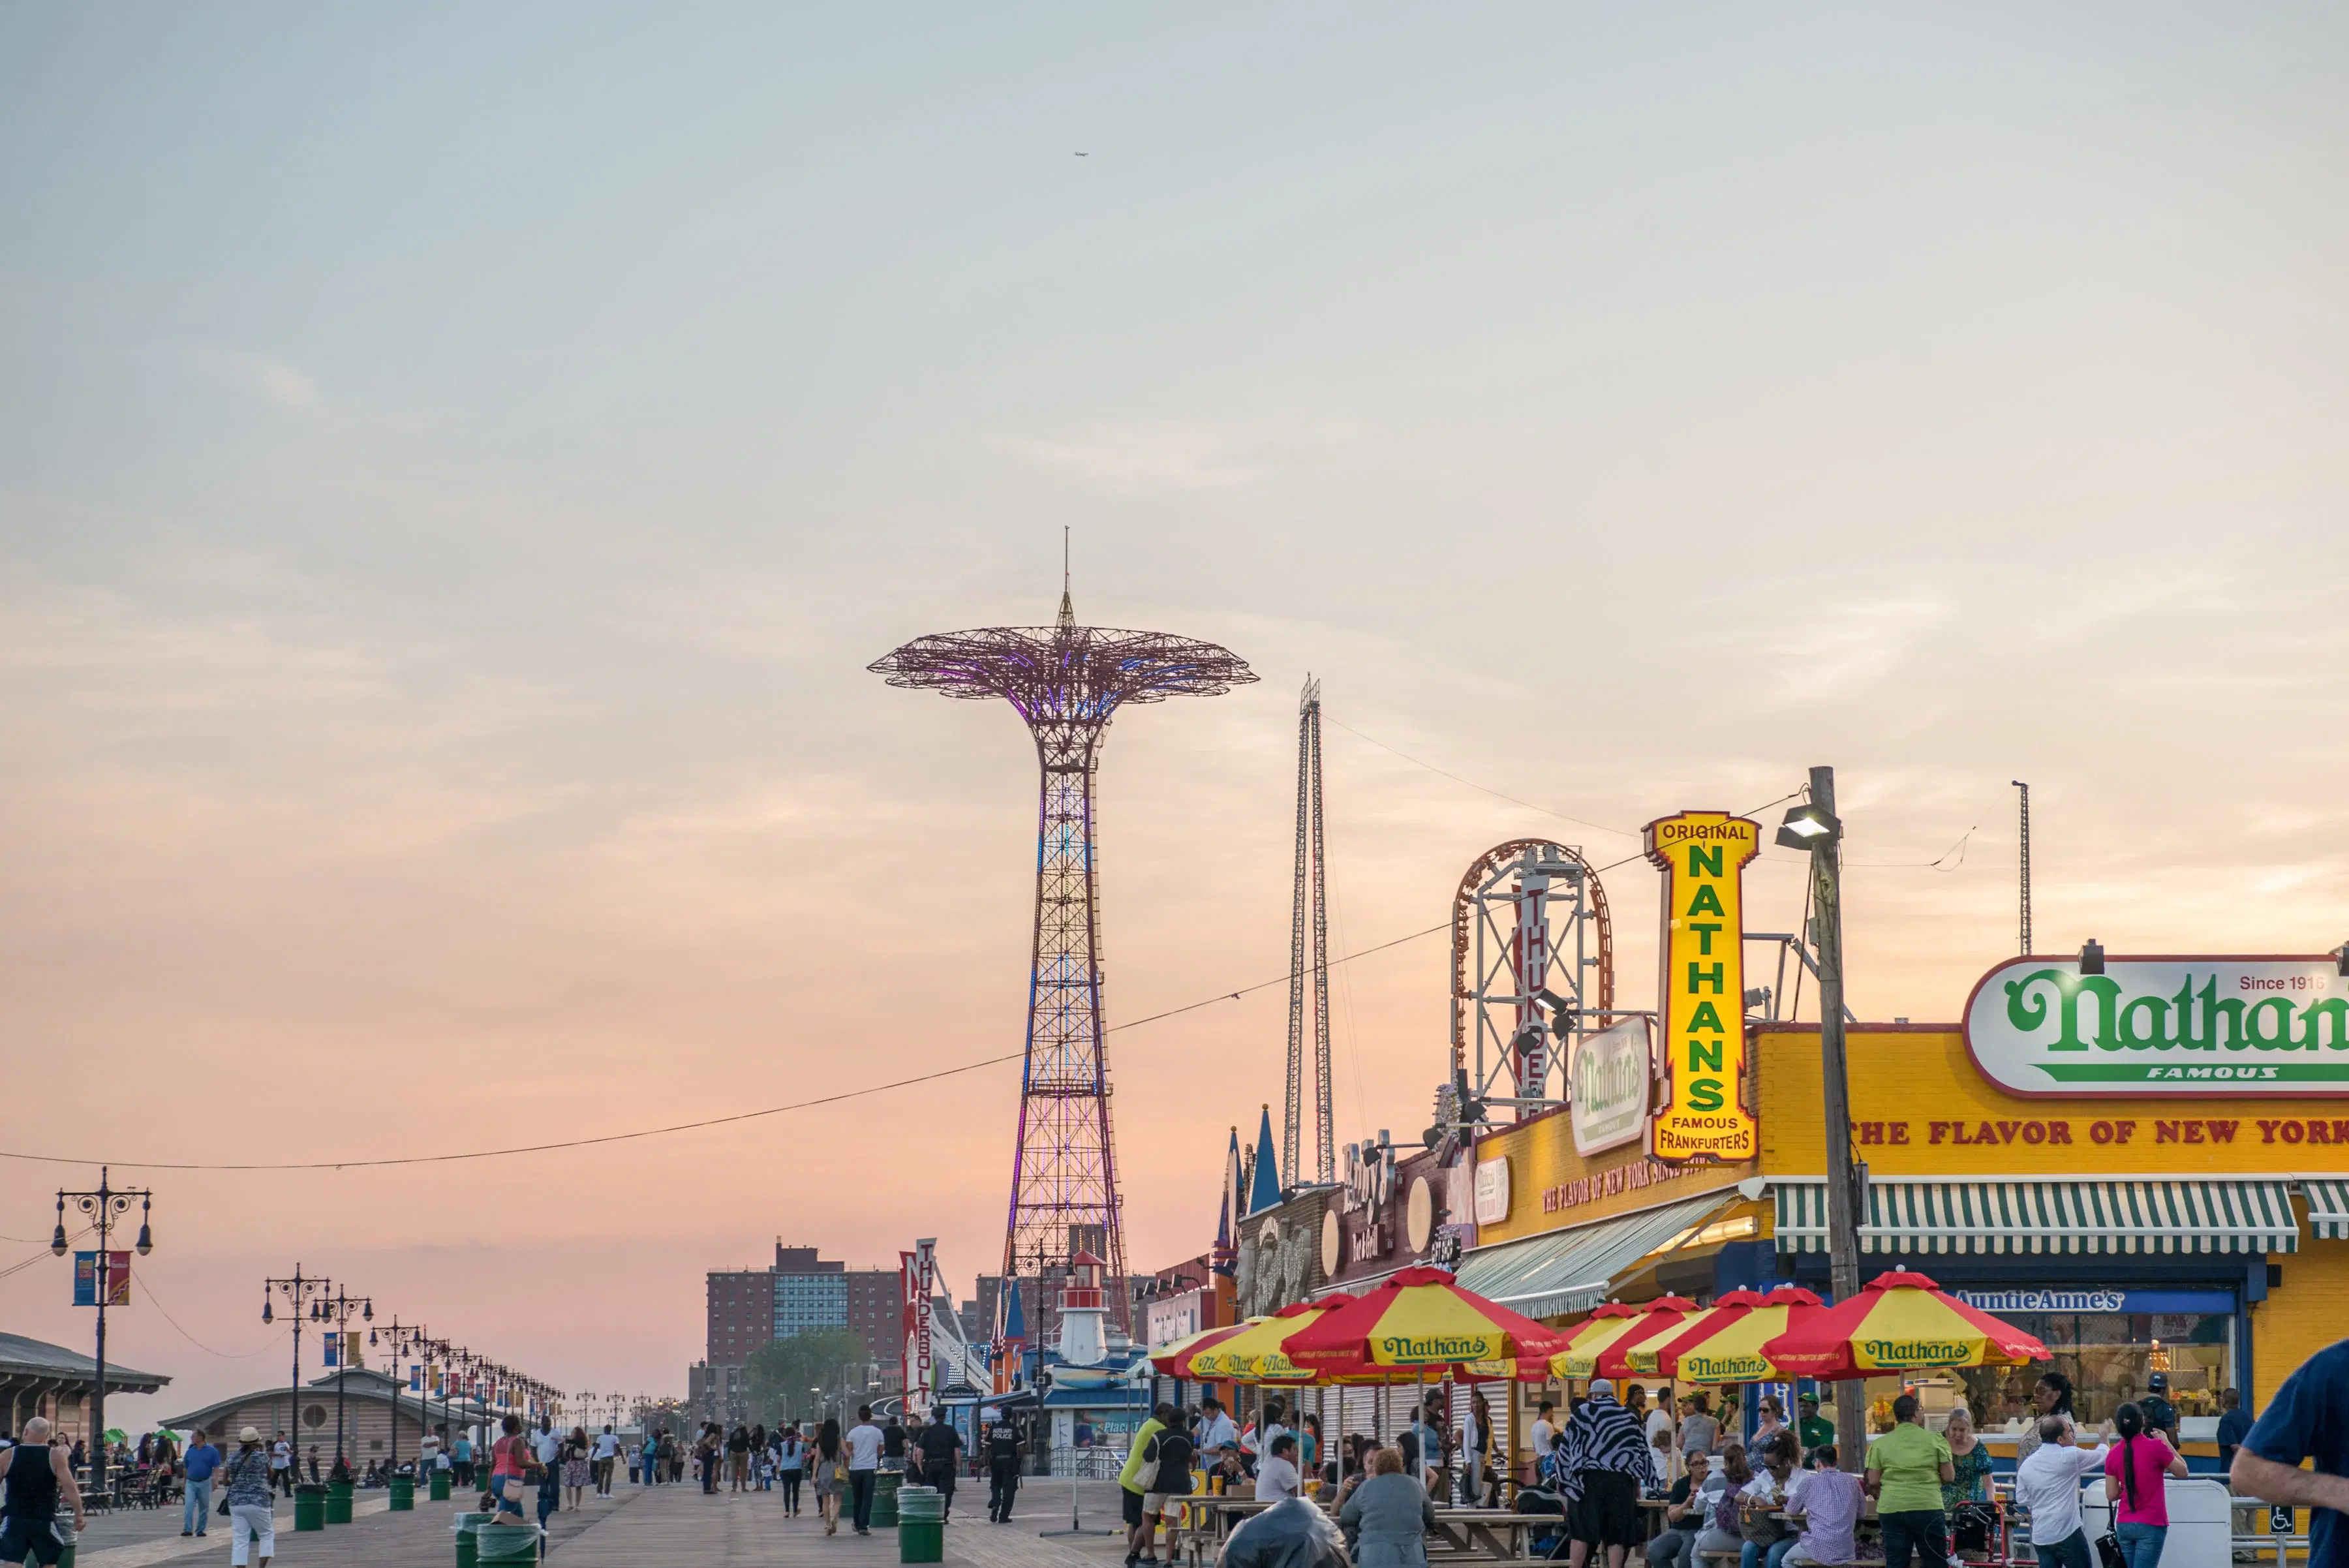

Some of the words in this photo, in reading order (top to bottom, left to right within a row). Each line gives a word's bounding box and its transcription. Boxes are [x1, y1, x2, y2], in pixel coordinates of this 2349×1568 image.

[1663, 824, 1749, 840] ORIGINAL
[1686, 845, 1726, 1111] NATHANS
[2240, 976, 2284, 990] Since
[2290, 976, 2325, 990] 1916
[2004, 969, 2349, 1052] Nathan
[2146, 1067, 2279, 1079] FAMOUS
[1672, 1118, 1738, 1129] FAMOUS
[1928, 1120, 2073, 1145] FLAVOR
[2090, 1120, 2137, 1144] OF
[2155, 1120, 2240, 1144] NEW
[2256, 1120, 2349, 1145] YORK
[1660, 1128, 1749, 1150] FRANKFURTERS
[1543, 1186, 1558, 1214] THE
[1559, 1177, 1591, 1208] FLAVOR
[1592, 1173, 1603, 1199] OF
[1605, 1166, 1625, 1196] NEW
[1627, 1160, 1650, 1190] YORK
[917, 1244, 933, 1405] THUNDERBOLT
